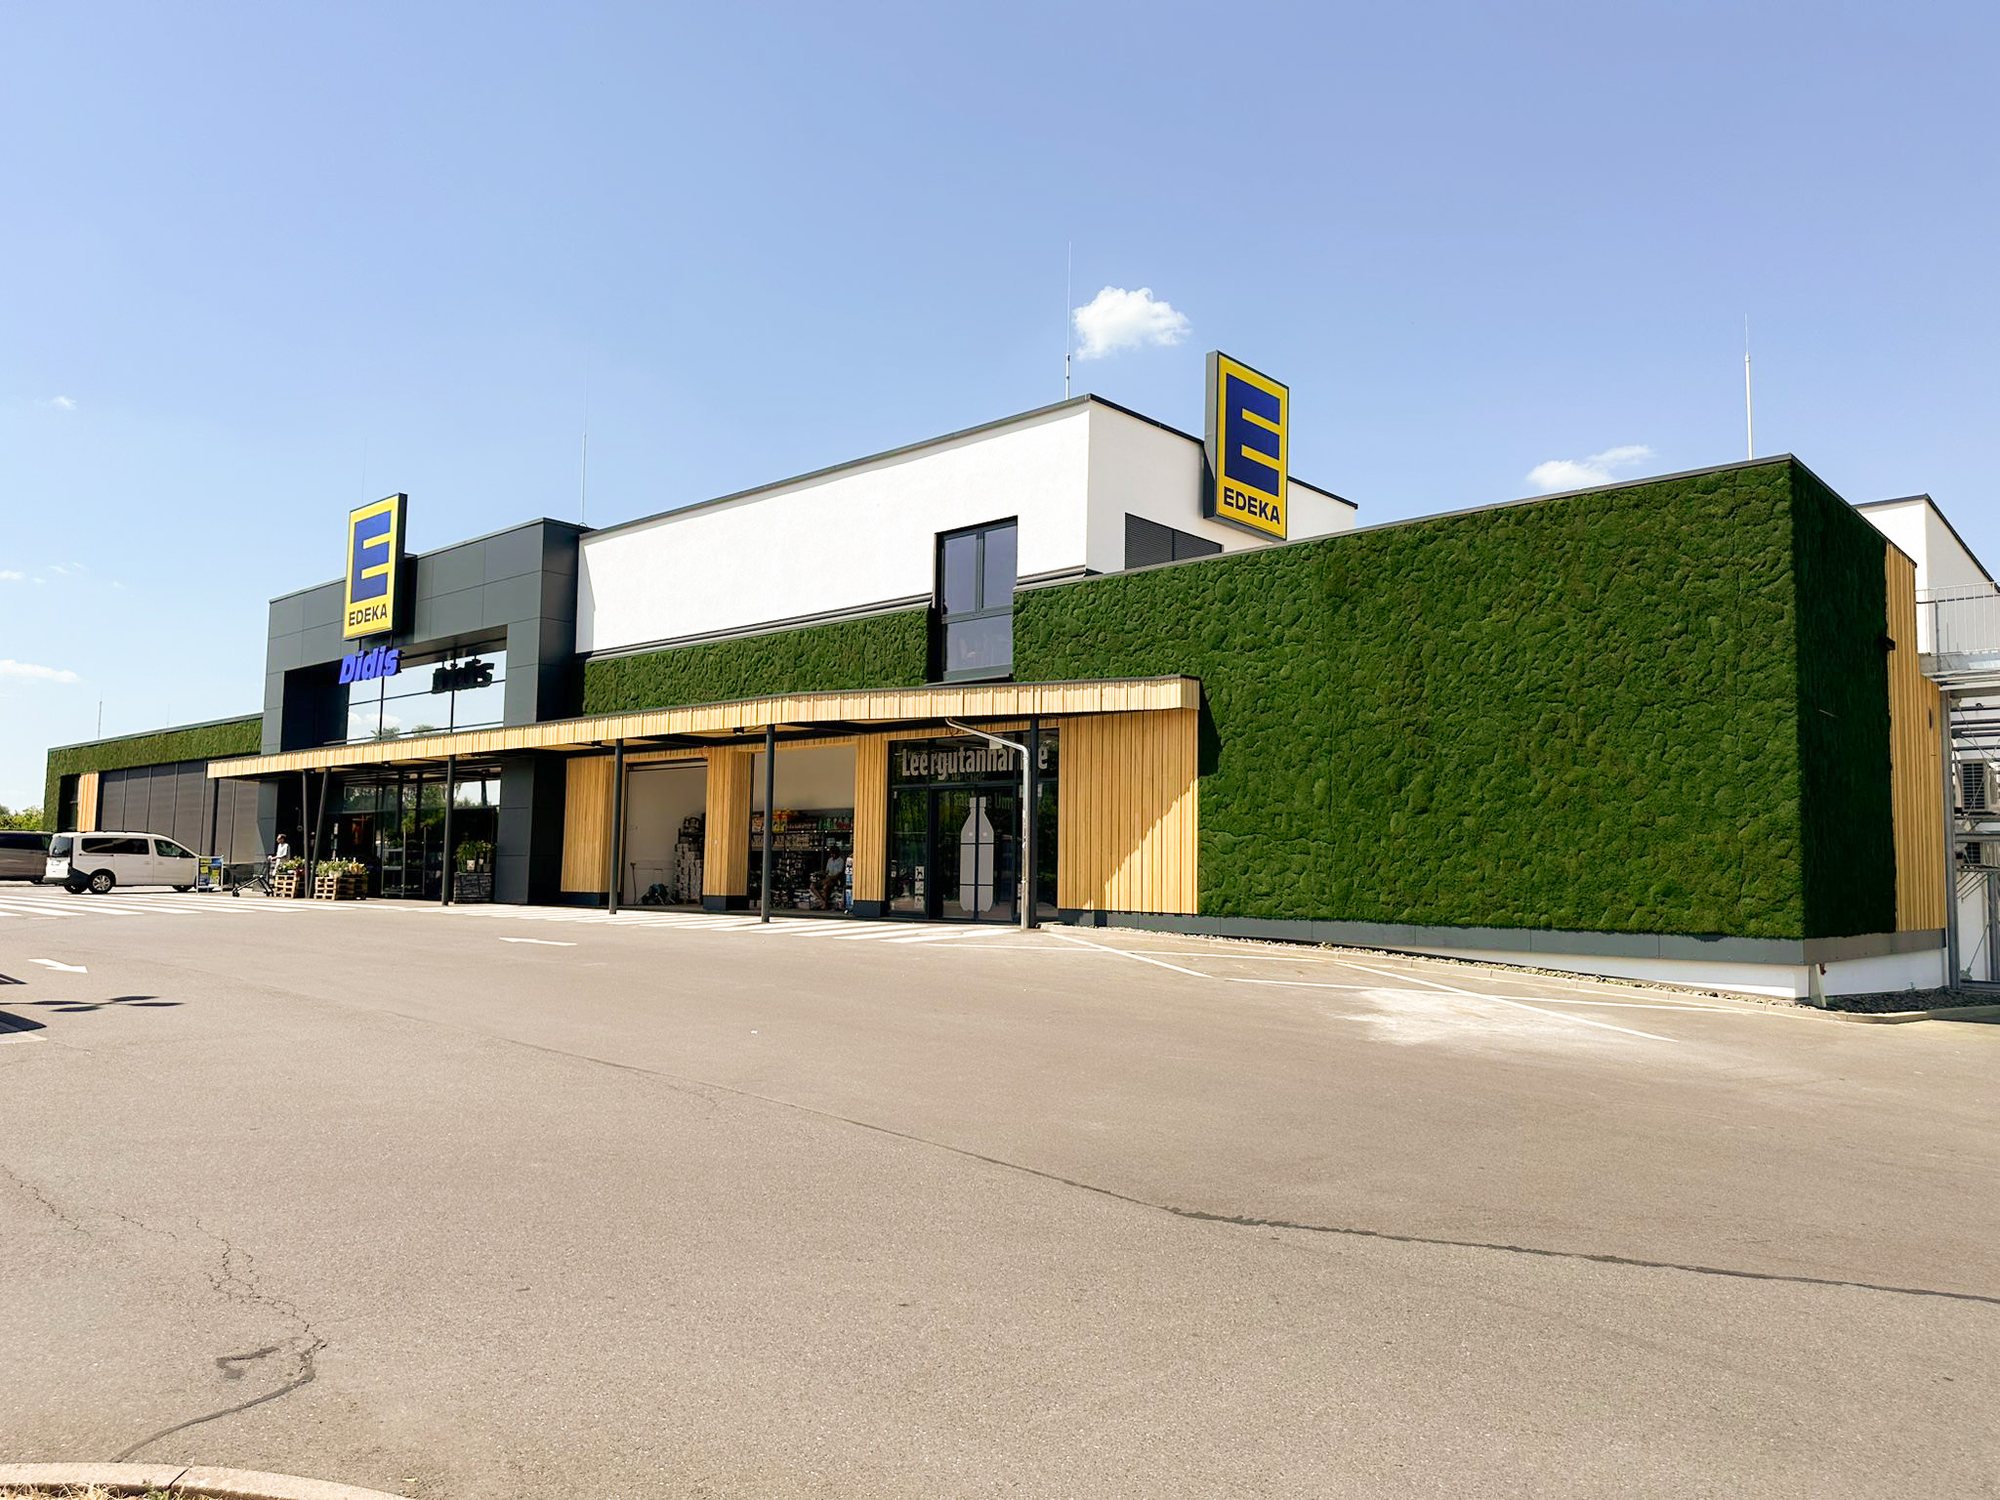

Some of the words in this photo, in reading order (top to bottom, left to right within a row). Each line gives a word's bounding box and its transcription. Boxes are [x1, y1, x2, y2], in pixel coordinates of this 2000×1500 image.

[1225, 373, 1280, 497] E
[1223, 486, 1280, 525] EDEKA
[351, 510, 391, 604] E
[348, 603, 388, 627] EDEKA
[339, 645, 400, 685] Didis
[901, 745, 1049, 781] Leergutannae
